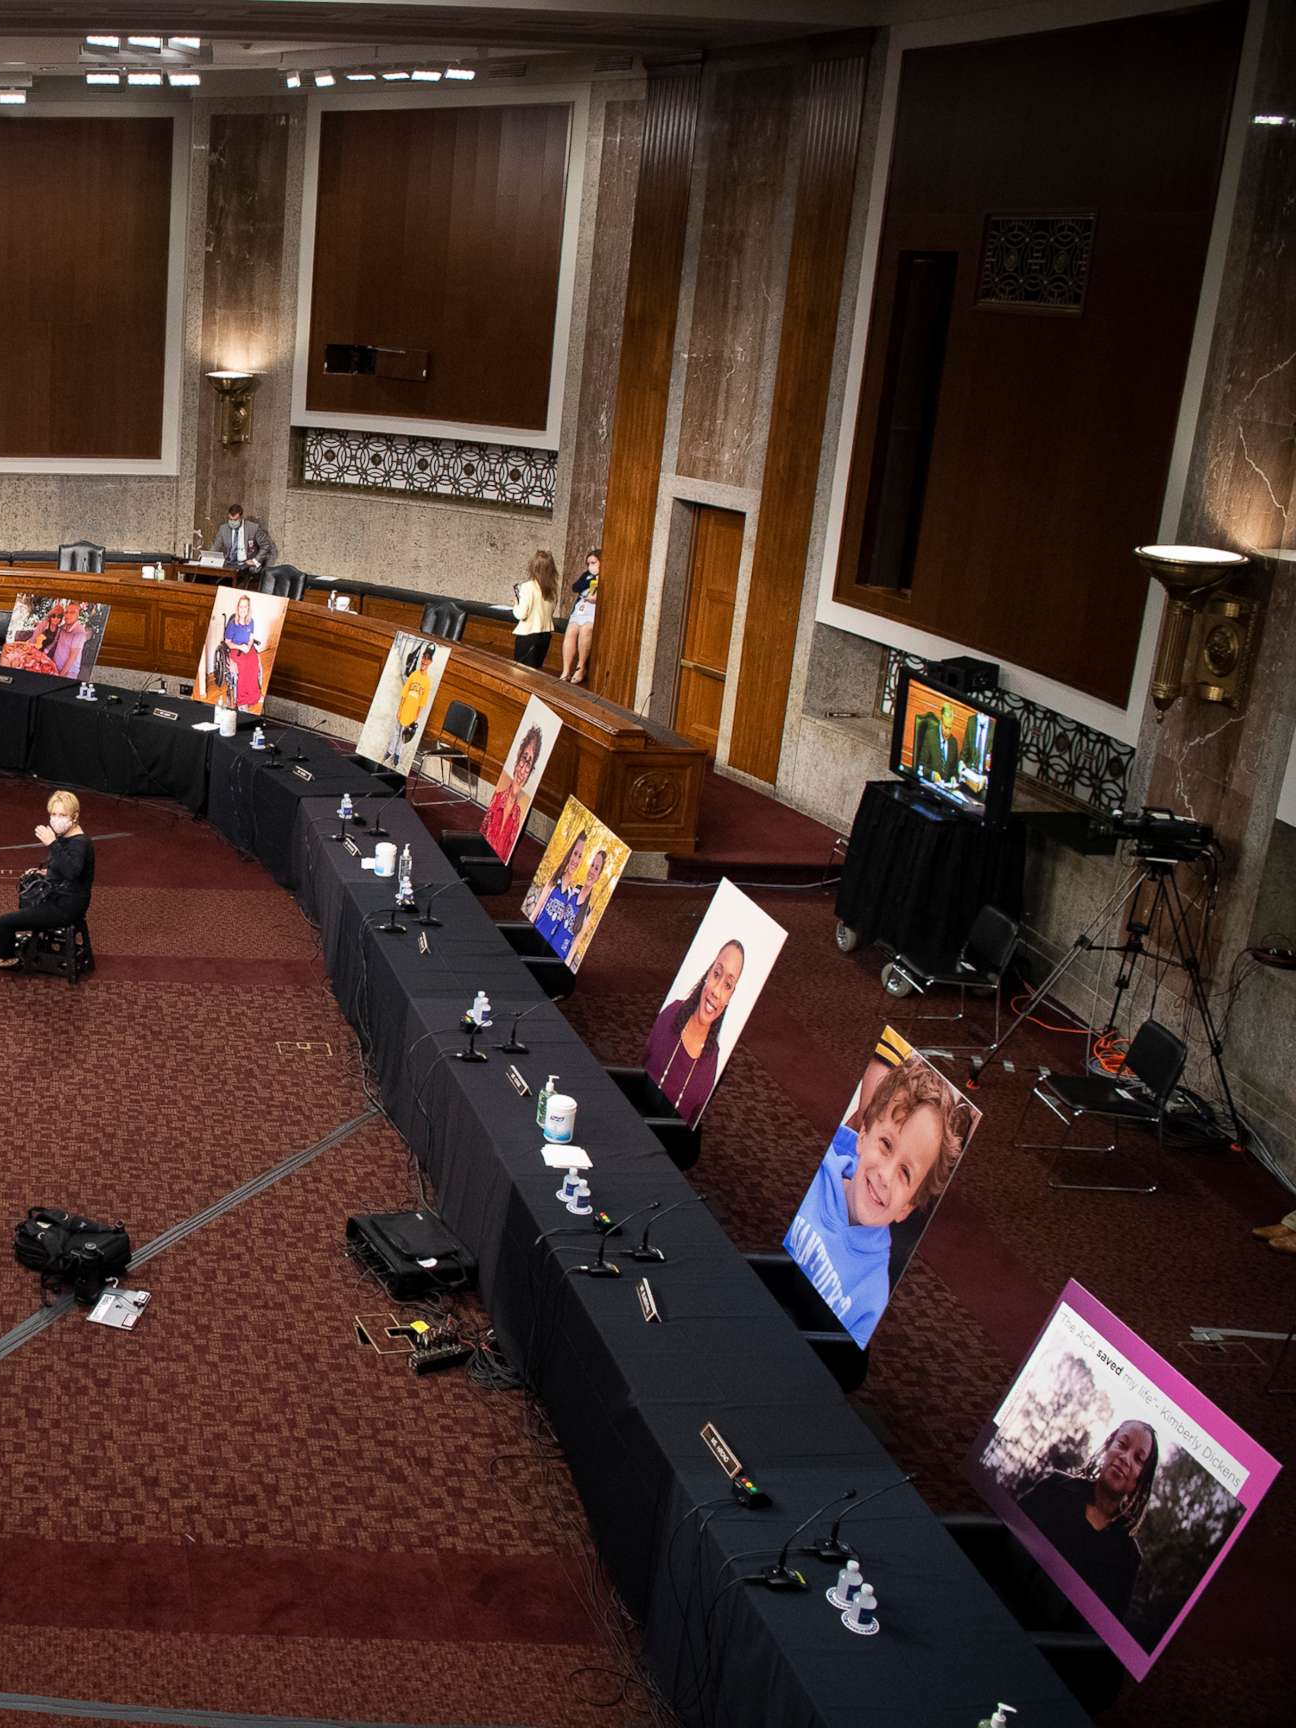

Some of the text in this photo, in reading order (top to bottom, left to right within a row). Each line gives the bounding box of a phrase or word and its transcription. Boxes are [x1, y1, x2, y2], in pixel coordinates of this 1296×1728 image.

[1096, 1350, 1124, 1376] saved
[1122, 1373, 1139, 1391] my
[1160, 1405, 1202, 1450] Kimberly
[1201, 1445, 1241, 1488] Dickens
